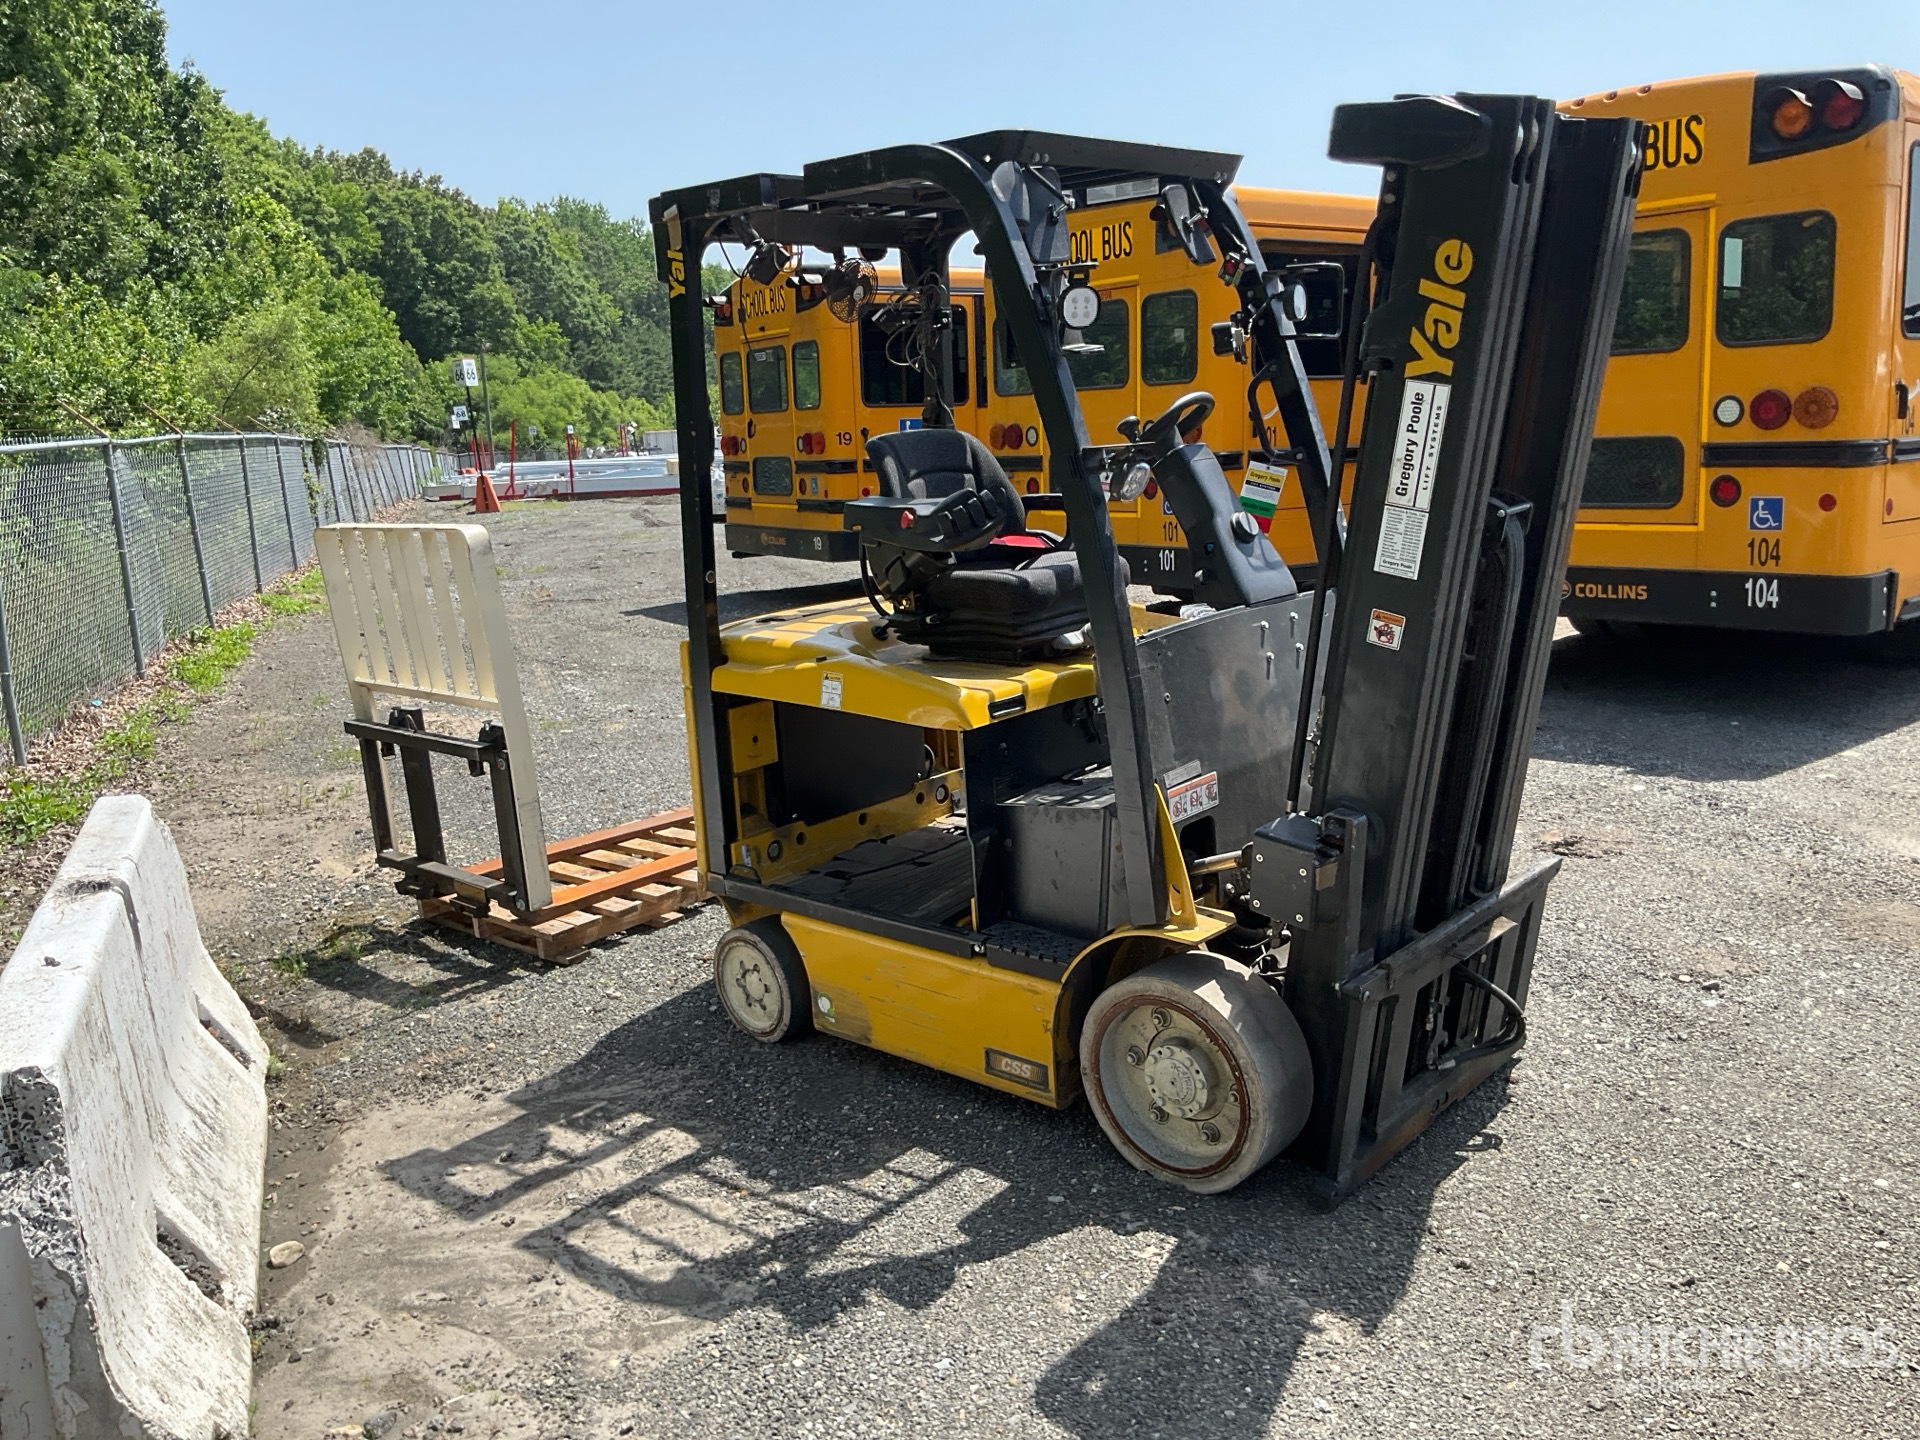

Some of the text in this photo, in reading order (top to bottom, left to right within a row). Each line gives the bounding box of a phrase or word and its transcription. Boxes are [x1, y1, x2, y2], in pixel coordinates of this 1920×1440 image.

[1643, 114, 1703, 171] BUS
[1069, 221, 1133, 264] OOL BUS
[667, 249, 686, 299] Yal
[769, 285, 786, 313] BUS
[1404, 238, 1473, 378] Yale
[455, 369, 465, 381] 66
[466, 368, 476, 380] 66
[456, 410, 466, 418] 68
[1406, 391, 1425, 434] Poole
[836, 431, 852, 446] 19
[1422, 404, 1443, 491] LIFT SYSTEMS
[1395, 438, 1419, 497] Gregory
[813, 536, 822, 551] 19
[1162, 521, 1179, 542] 101
[1158, 549, 1175, 571] 101
[1747, 537, 1781, 567] 104
[1575, 577, 1779, 609] COLLINS 104
[1001, 1058, 1031, 1078] CSS
